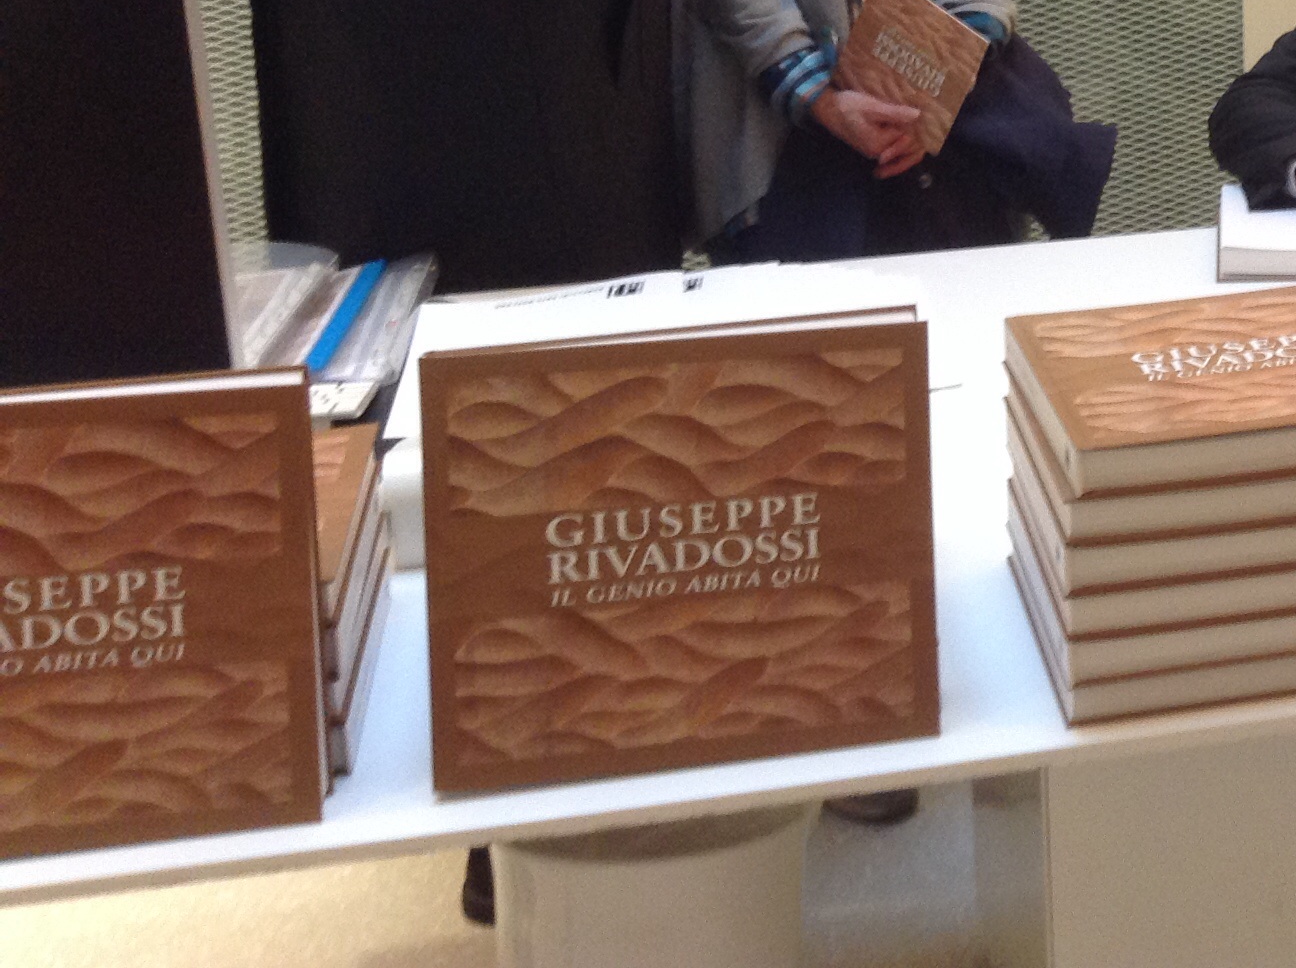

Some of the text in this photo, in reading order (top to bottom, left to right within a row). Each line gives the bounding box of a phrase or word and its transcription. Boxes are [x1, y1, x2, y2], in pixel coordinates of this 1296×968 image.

[545, 491, 821, 548] GIUSEPPE
[546, 526, 821, 584] RIVADOSSI
[551, 562, 821, 607] IL GENIO ABITA QUI
[33, 648, 119, 674] ABITA
[130, 643, 186, 669] QUI
